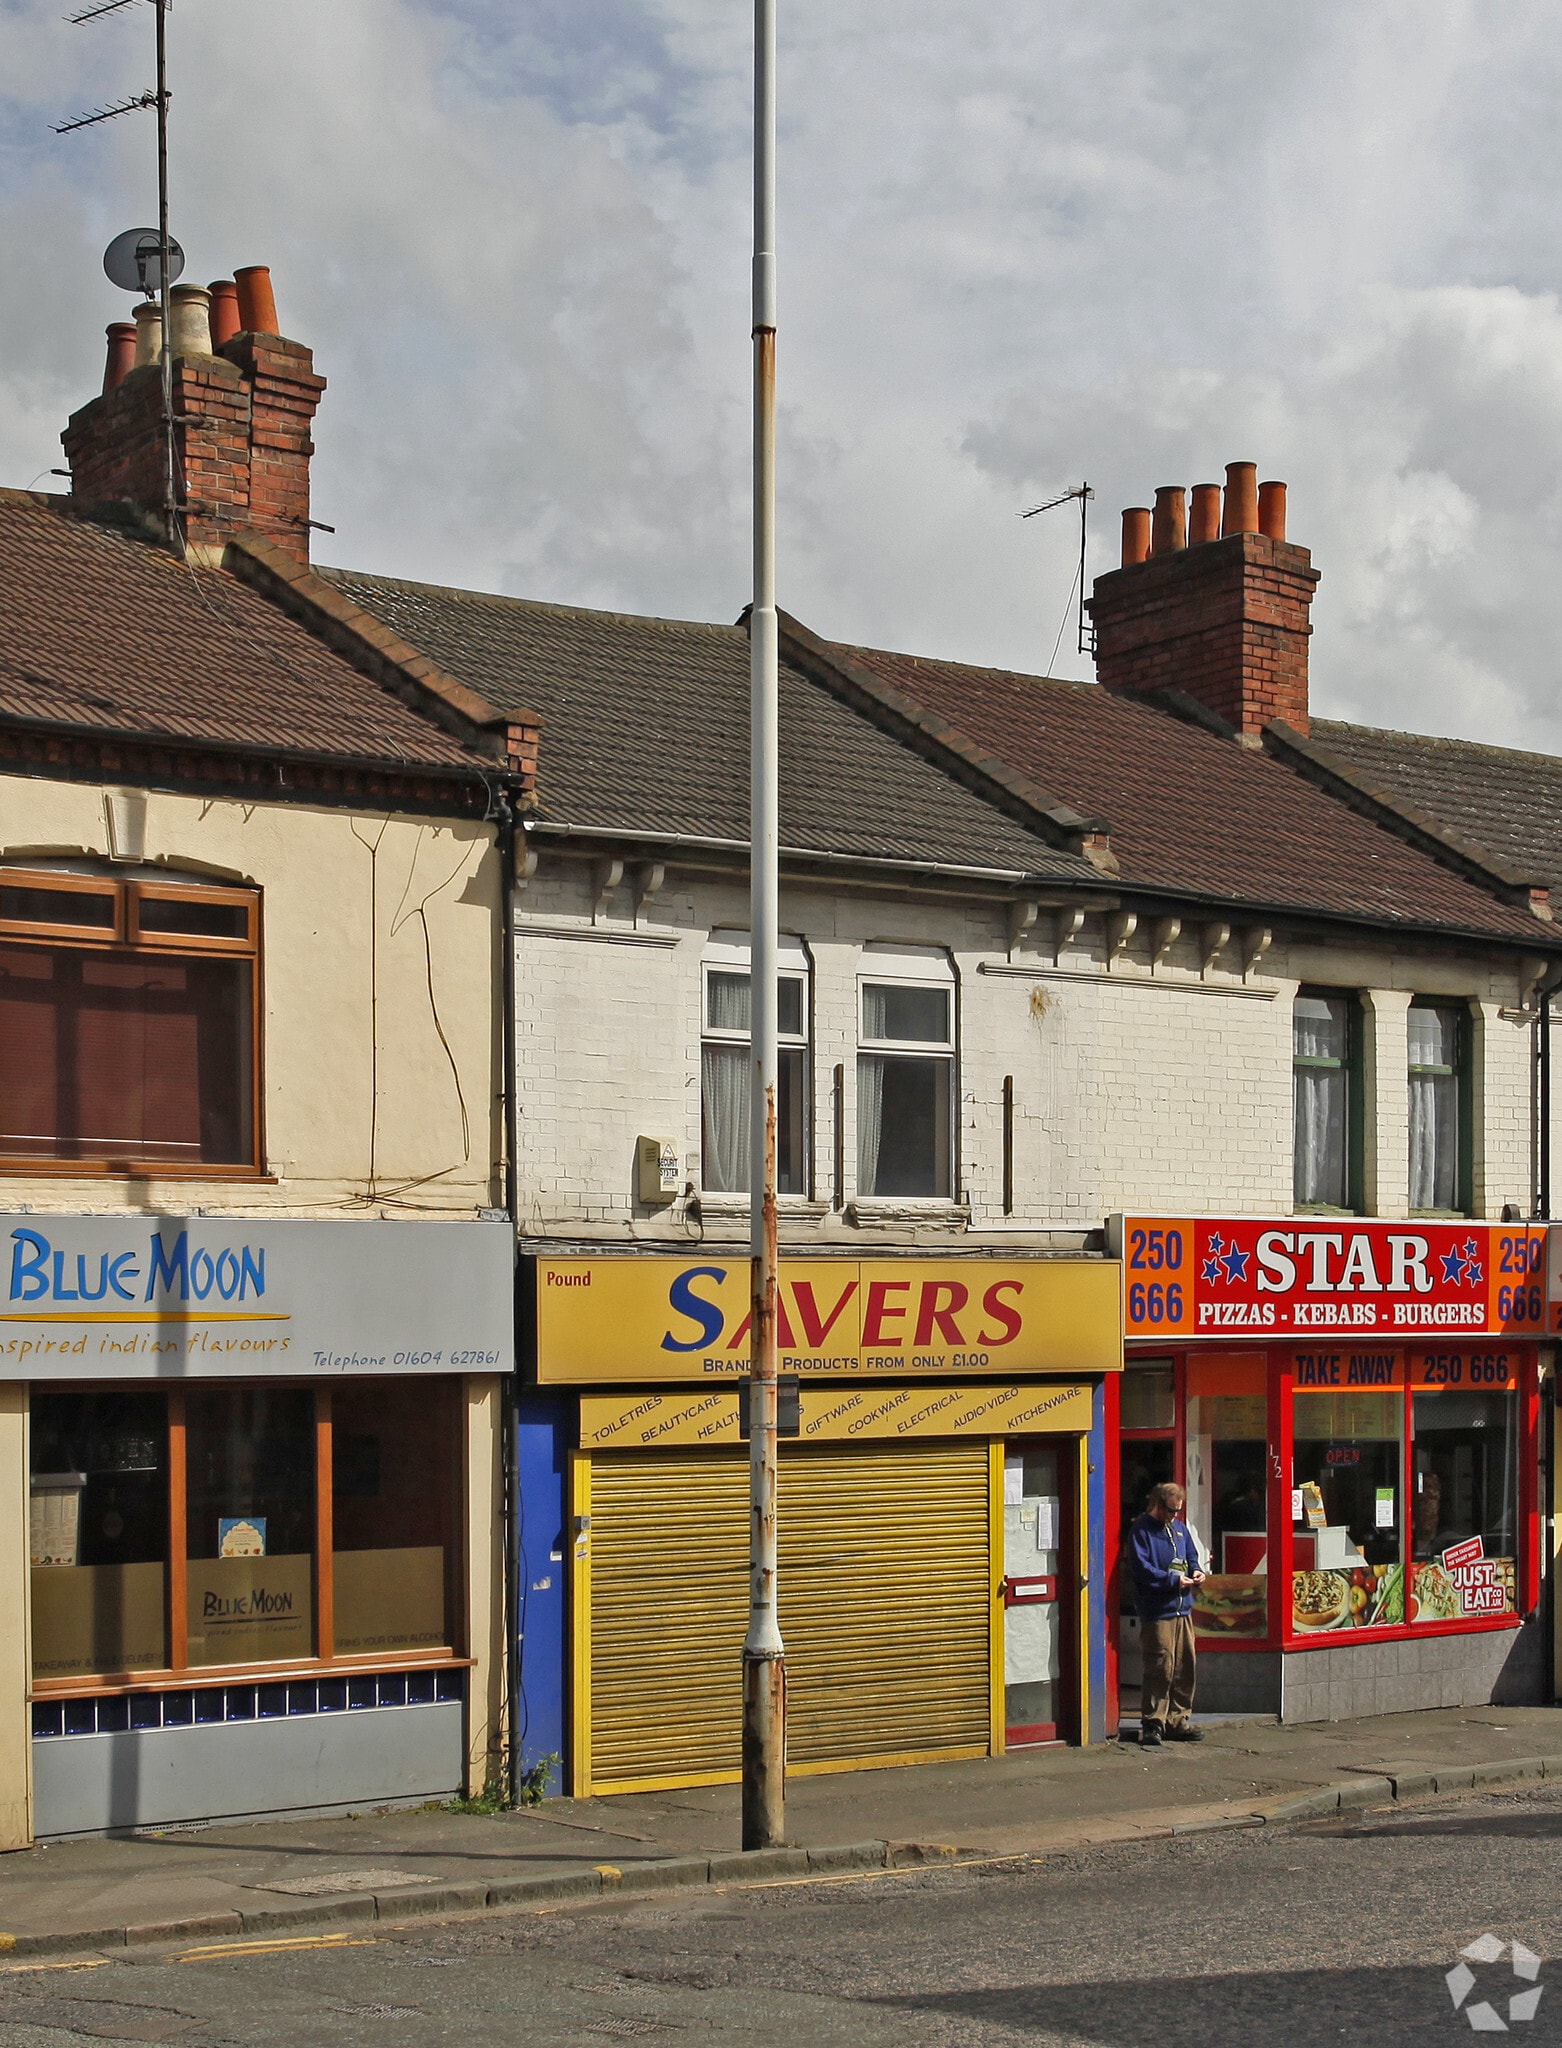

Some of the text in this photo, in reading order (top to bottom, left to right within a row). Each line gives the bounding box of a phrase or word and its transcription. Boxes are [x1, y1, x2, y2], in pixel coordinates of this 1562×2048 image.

[1130, 1229, 1183, 1270] 250
[1255, 1230, 1434, 1293] STAR
[1499, 1236, 1542, 1274] 250
[547, 1270, 591, 1287] Pound
[1129, 1283, 1183, 1323] 666
[1198, 1303, 1276, 1326] PIZZAS
[1293, 1303, 1377, 1326] KEBABS
[1393, 1303, 1485, 1326] BURGERS
[1498, 1284, 1542, 1322] 666
[0, 1330, 291, 1363] spired indian flavours
[313, 1350, 500, 1371] Telephone 01604 627861
[952, 1353, 989, 1368] £1.00
[1296, 1355, 1395, 1385] TAKE AWAY
[1424, 1354, 1509, 1383] 250 666
[592, 1394, 663, 1443] TOILETRIES
[640, 1394, 722, 1443] BEAUTYCARE
[805, 1393, 864, 1435] GIFTWARE
[847, 1390, 911, 1435] COOKWARE
[896, 1391, 964, 1433] ELECTRICAL
[953, 1387, 1020, 1430] AUDIO/VIDEO
[1007, 1385, 1081, 1429] KITCHENWARE
[1326, 1448, 1361, 1464] OPEN
[1455, 1565, 1493, 1588] JUST
[1464, 1587, 1493, 1609] EAT
[363, 1635, 386, 1646] YOUR
[33, 1658, 82, 1671] TAKEAWAY
